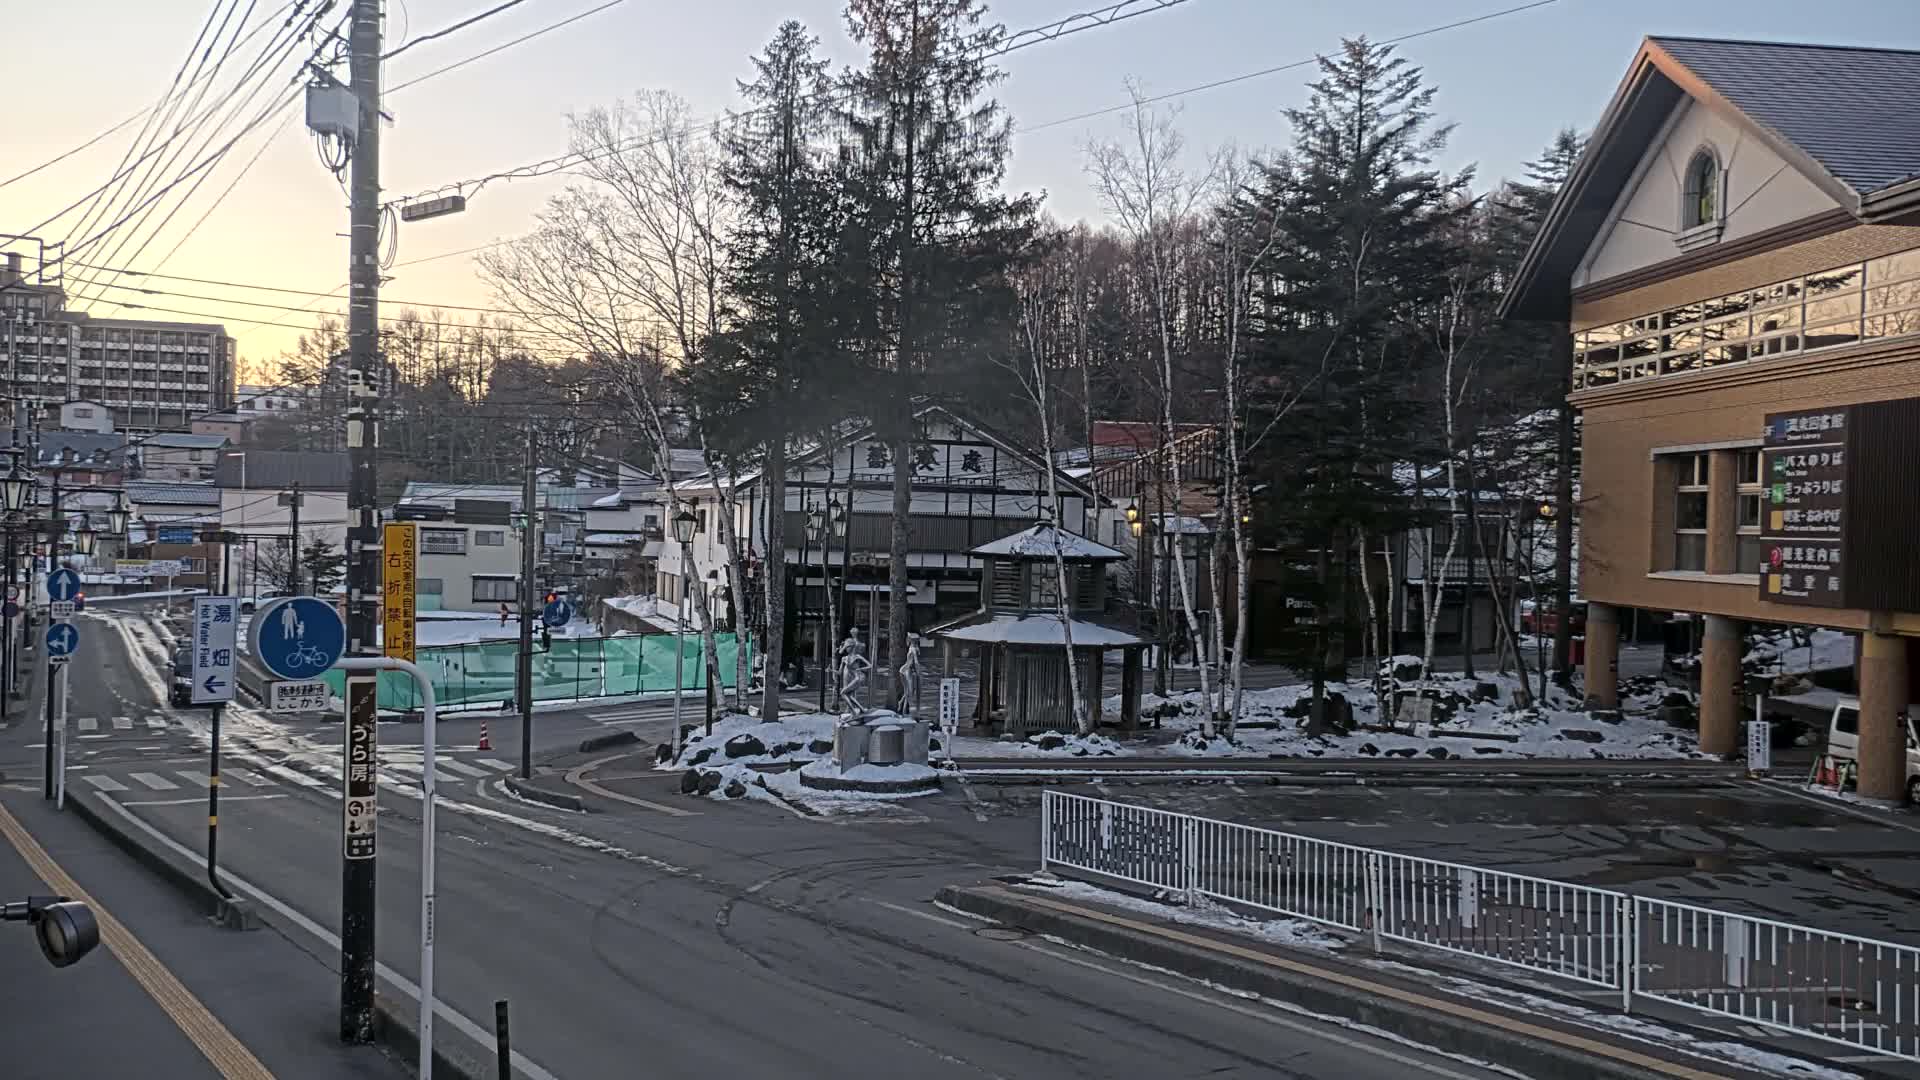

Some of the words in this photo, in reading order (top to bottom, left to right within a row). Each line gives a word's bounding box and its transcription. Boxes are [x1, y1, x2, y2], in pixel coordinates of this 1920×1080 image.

[1785, 452, 1843, 467] バスのりば
[387, 552, 402, 649] 右折禁止
[201, 604, 210, 619] Hot
[200, 621, 210, 643] Water
[212, 604, 231, 667] 湯畑
[200, 648, 210, 668] Field
[277, 697, 324, 709] ここから
